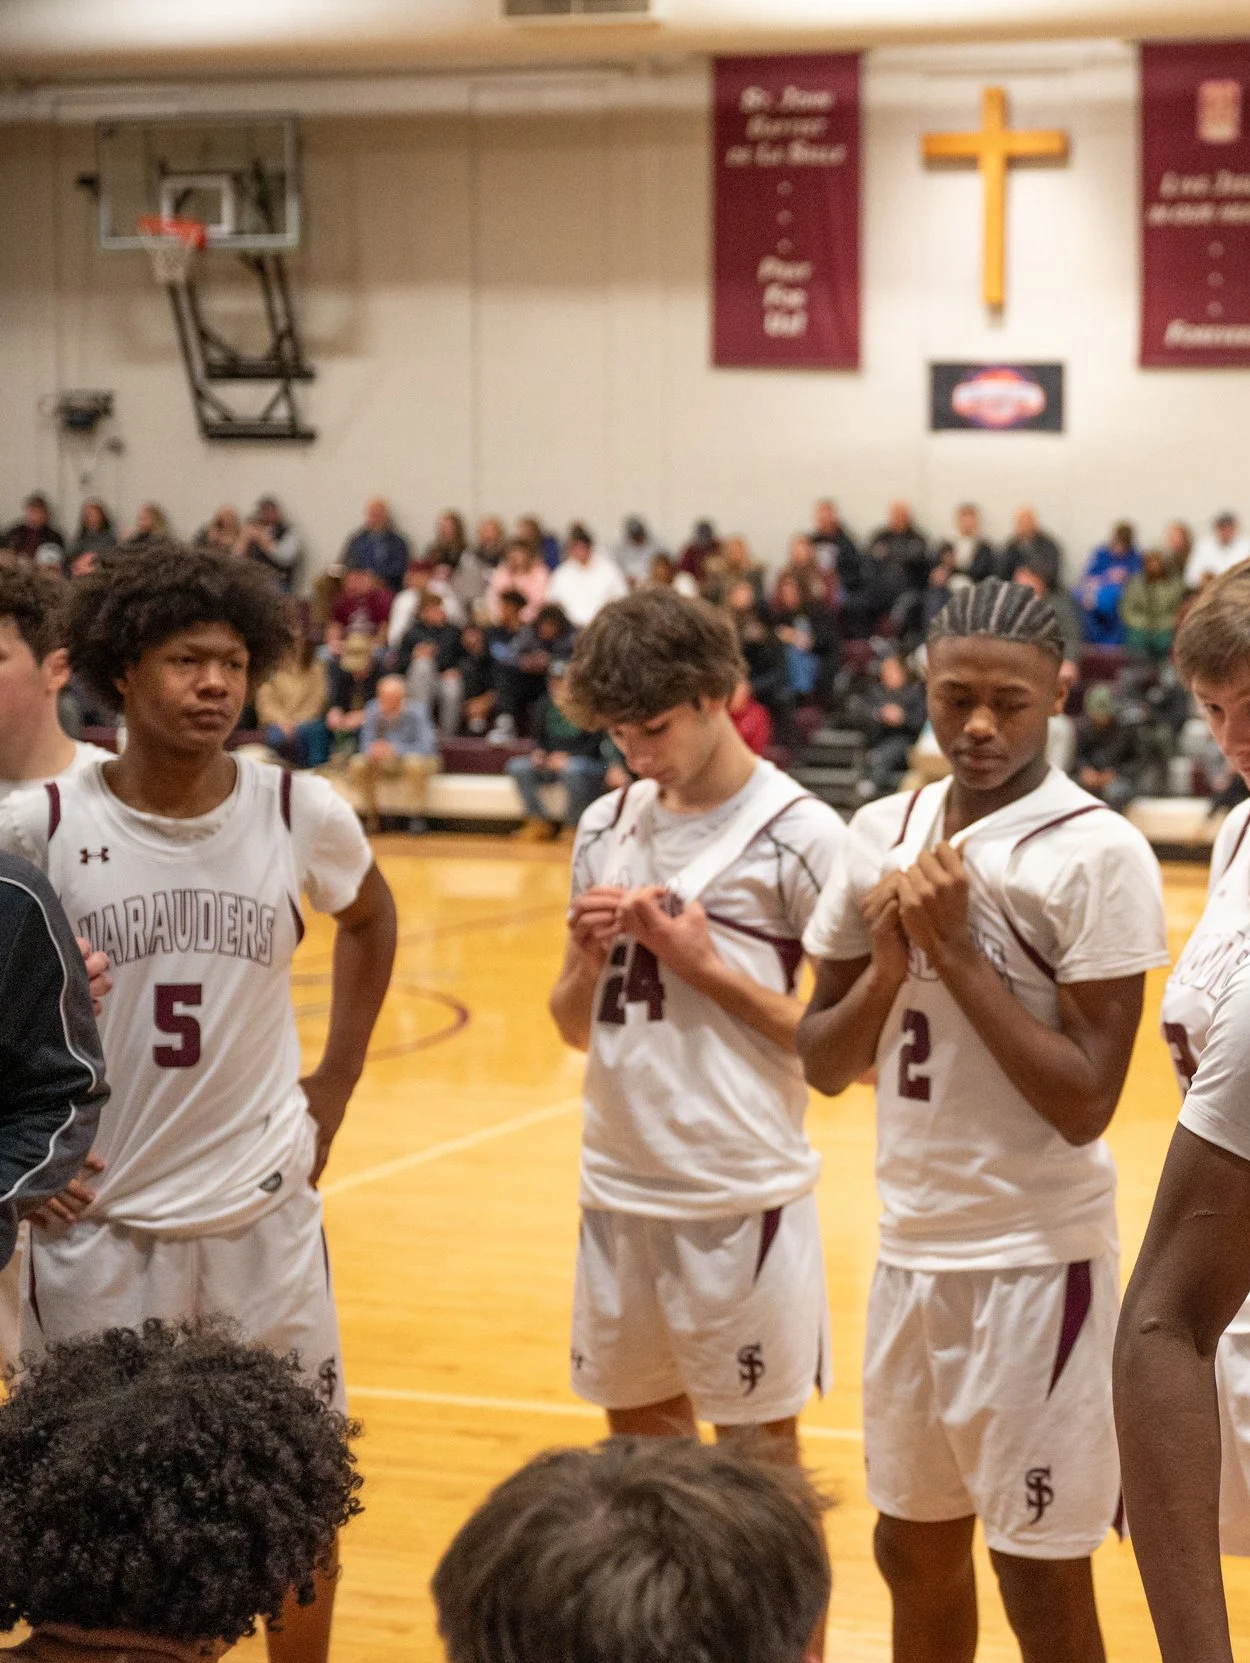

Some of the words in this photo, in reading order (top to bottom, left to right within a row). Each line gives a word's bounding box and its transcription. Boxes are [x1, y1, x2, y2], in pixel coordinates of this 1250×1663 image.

[77, 888, 275, 968] MARAUDERS
[152, 982, 203, 1068] 5
[898, 1008, 932, 1102] 2
